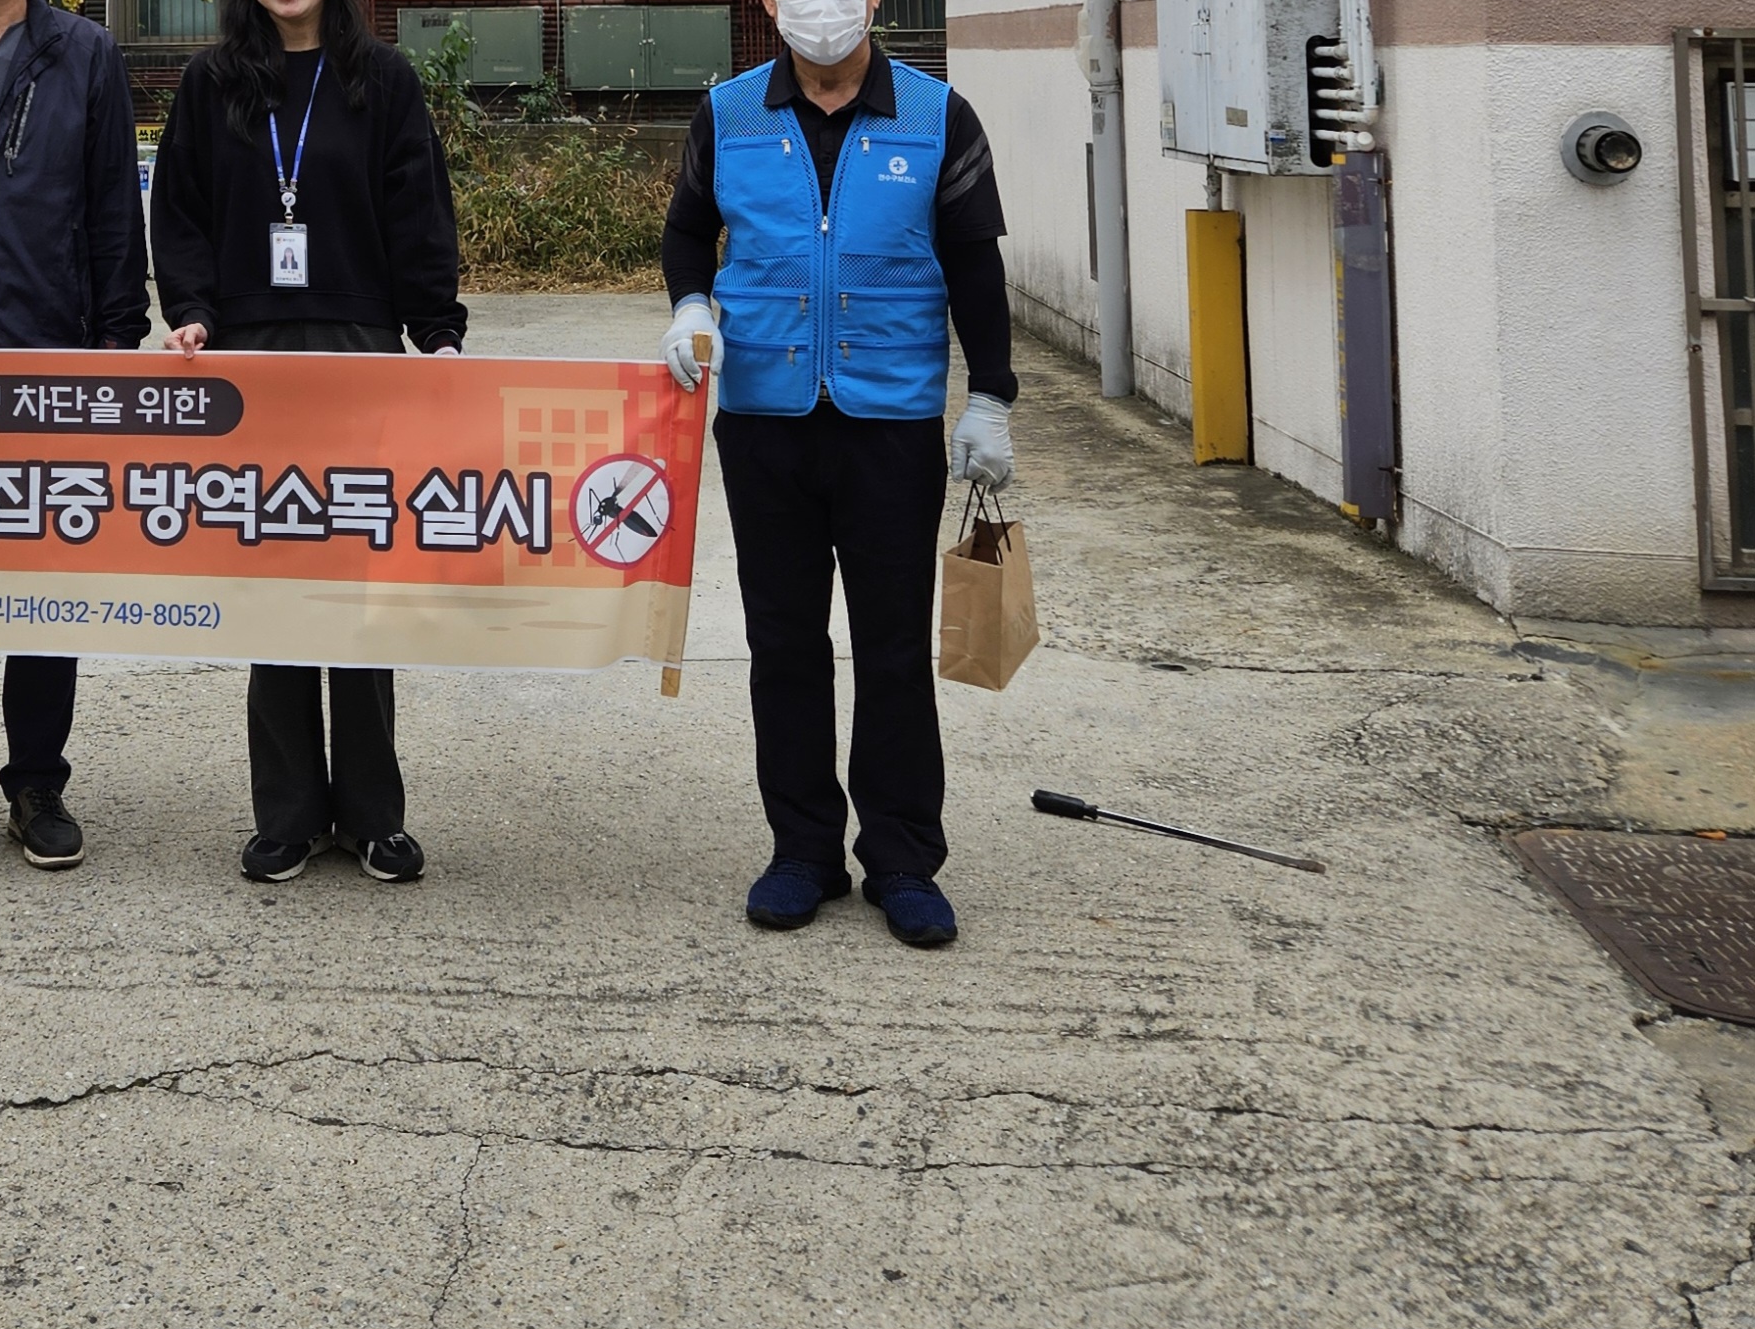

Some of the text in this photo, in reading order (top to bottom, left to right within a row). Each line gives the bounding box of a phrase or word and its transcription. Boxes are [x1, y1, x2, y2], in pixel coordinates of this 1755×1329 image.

[12, 384, 124, 424] 차단을
[135, 386, 211, 425] 위한
[128, 468, 393, 547] 방역소독
[413, 472, 547, 549] 실시
